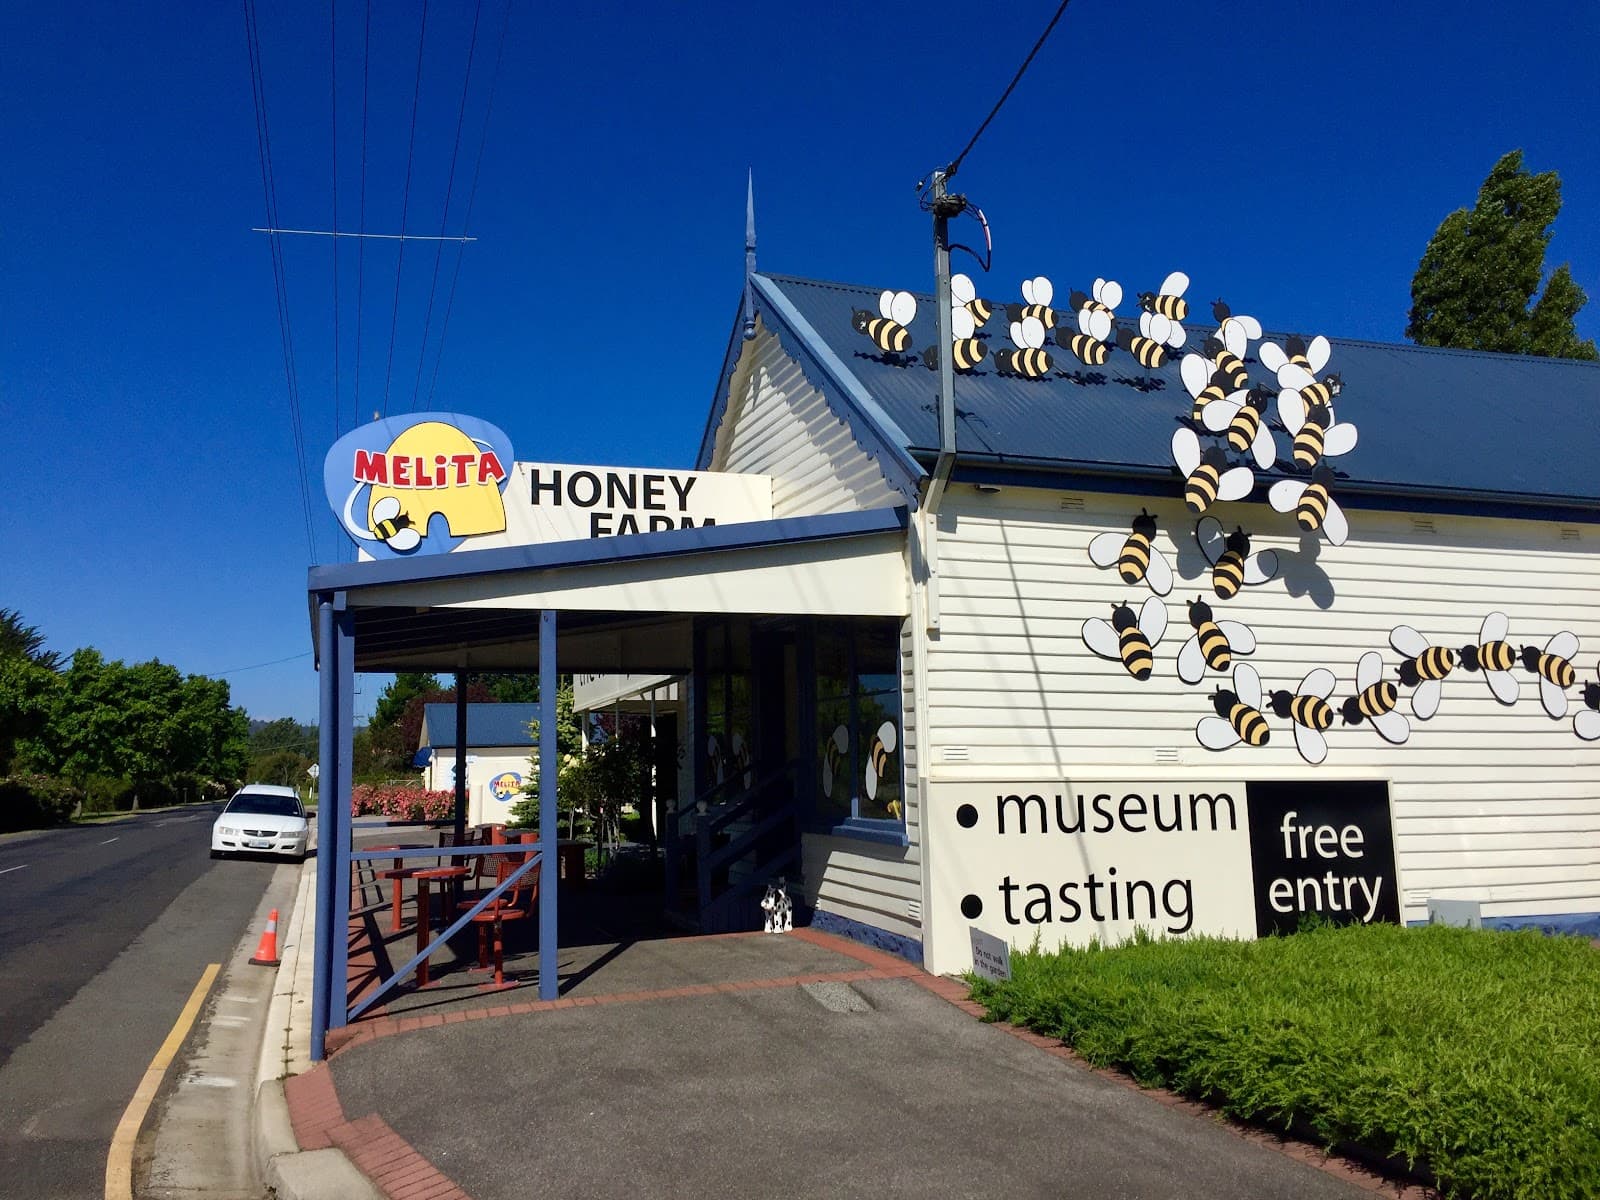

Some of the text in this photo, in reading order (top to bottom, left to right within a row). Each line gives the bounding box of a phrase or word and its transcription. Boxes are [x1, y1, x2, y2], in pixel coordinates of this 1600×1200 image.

[531, 469, 697, 511] HONEY
[591, 512, 716, 538] FA
[997, 793, 1237, 834] museum
[1280, 811, 1364, 859] free
[998, 866, 1194, 934] tasting
[1269, 870, 1383, 922] entry
